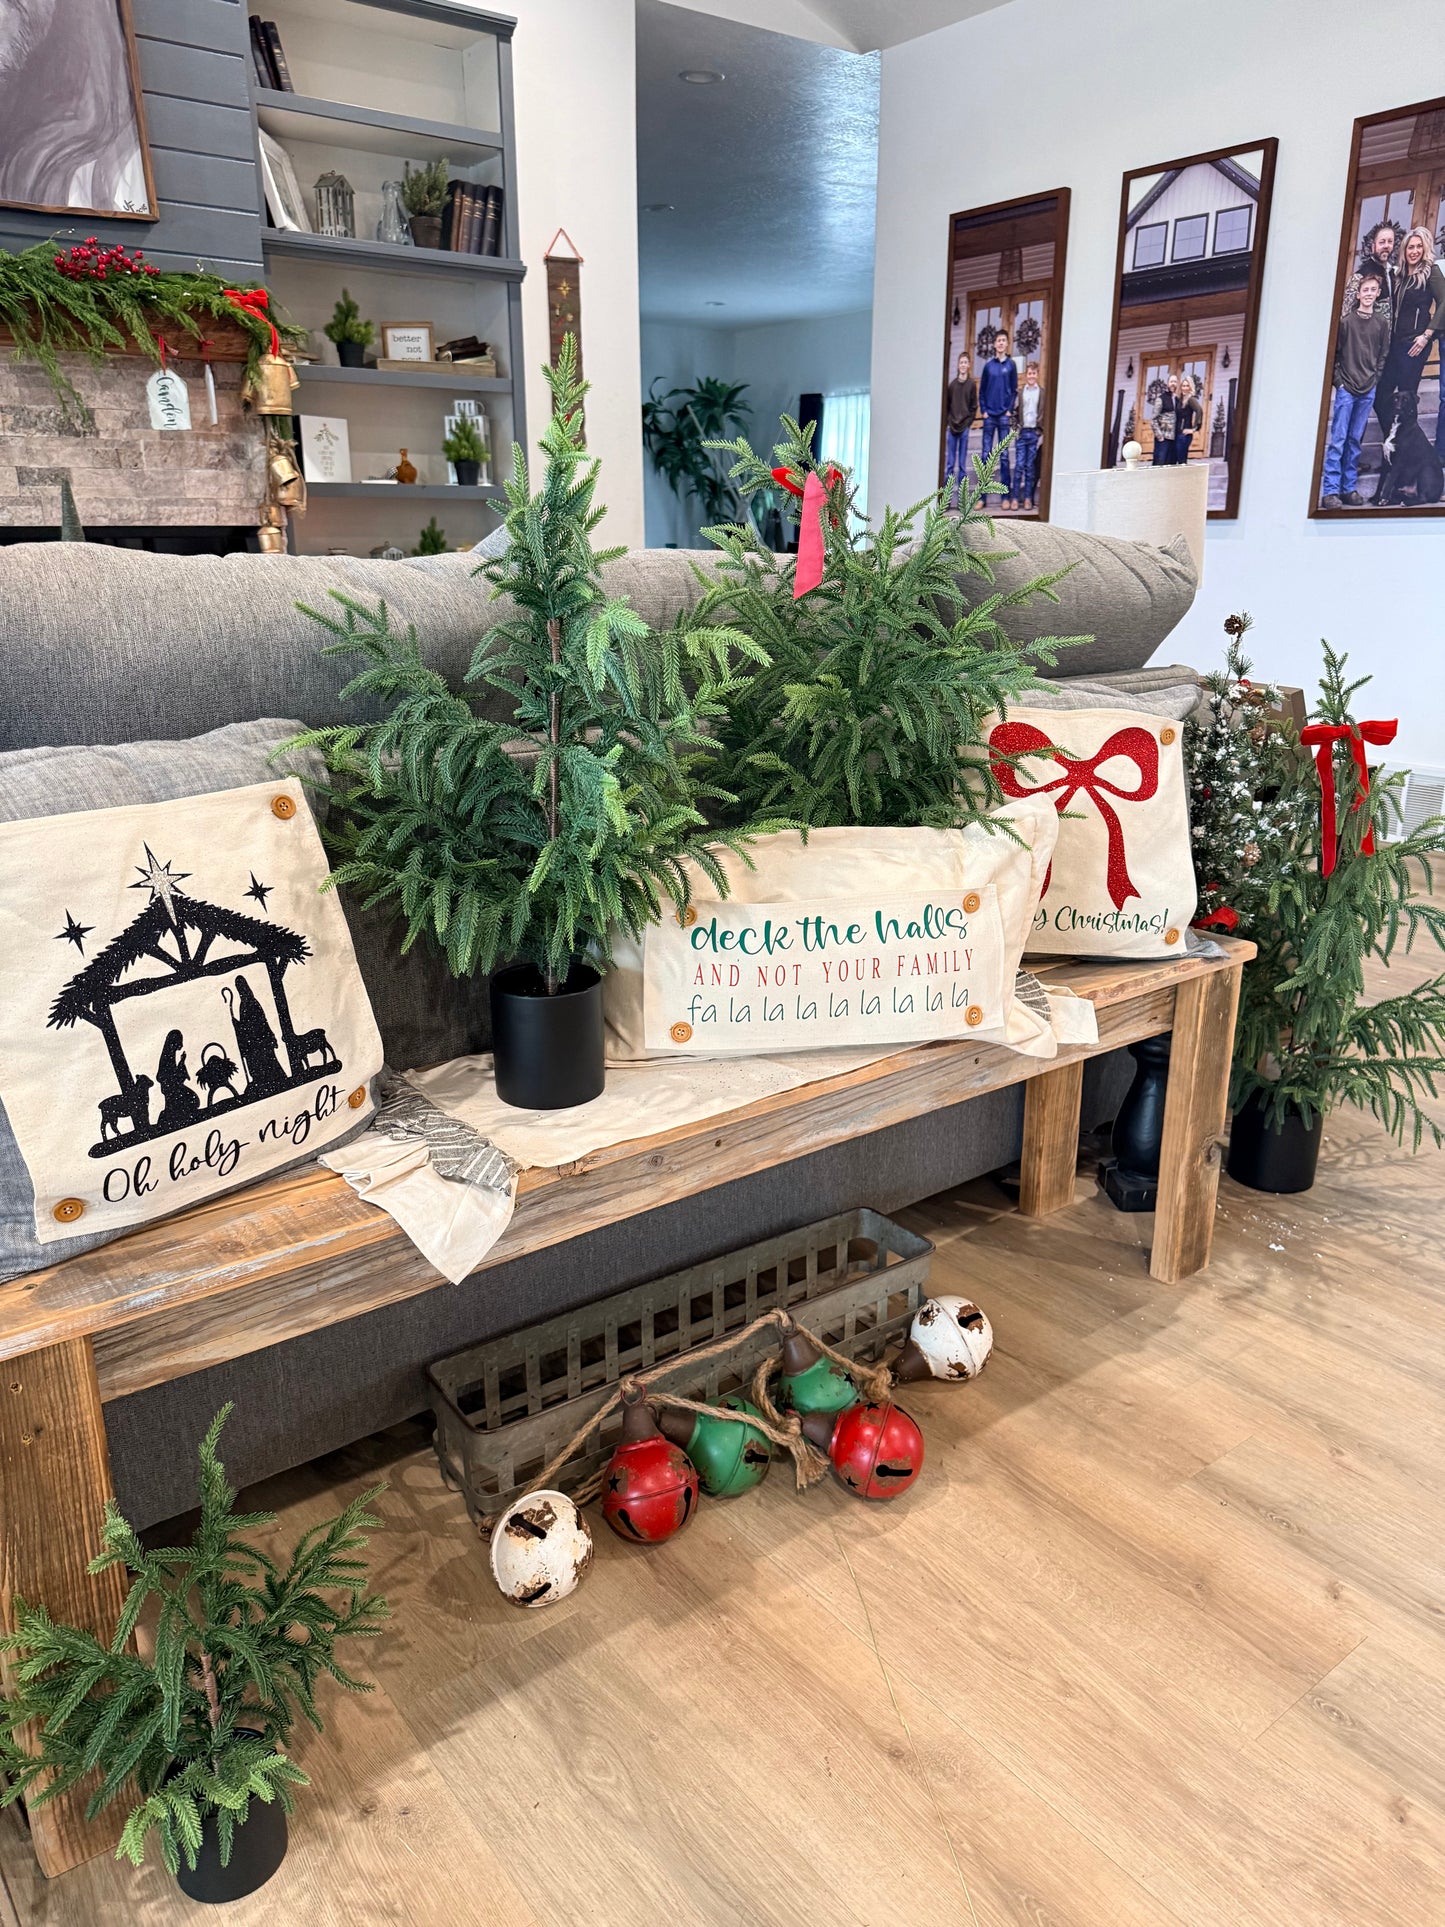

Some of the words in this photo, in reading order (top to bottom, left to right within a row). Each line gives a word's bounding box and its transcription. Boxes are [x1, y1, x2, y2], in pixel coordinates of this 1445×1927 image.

[393, 334, 422, 343] better
[691, 917, 794, 955] deck
[796, 915, 867, 952] the
[875, 903, 968, 944] halls
[1054, 905, 1169, 934] Christmas!
[693, 962, 740, 987] AND
[757, 963, 802, 988] NOT
[822, 957, 881, 984] YOUR
[897, 948, 974, 977] FAMILY
[687, 994, 717, 1026] fa
[729, 997, 751, 1023] la
[762, 996, 784, 1022] la
[796, 994, 817, 1020] la
[828, 992, 849, 1018] la
[860, 989, 881, 1015] la
[893, 986, 914, 1013] la
[925, 984, 943, 1012] la
[951, 982, 969, 1008] la
[103, 1156, 159, 1202] Oh
[169, 1129, 250, 1177] holy
[259, 1084, 346, 1145] night
